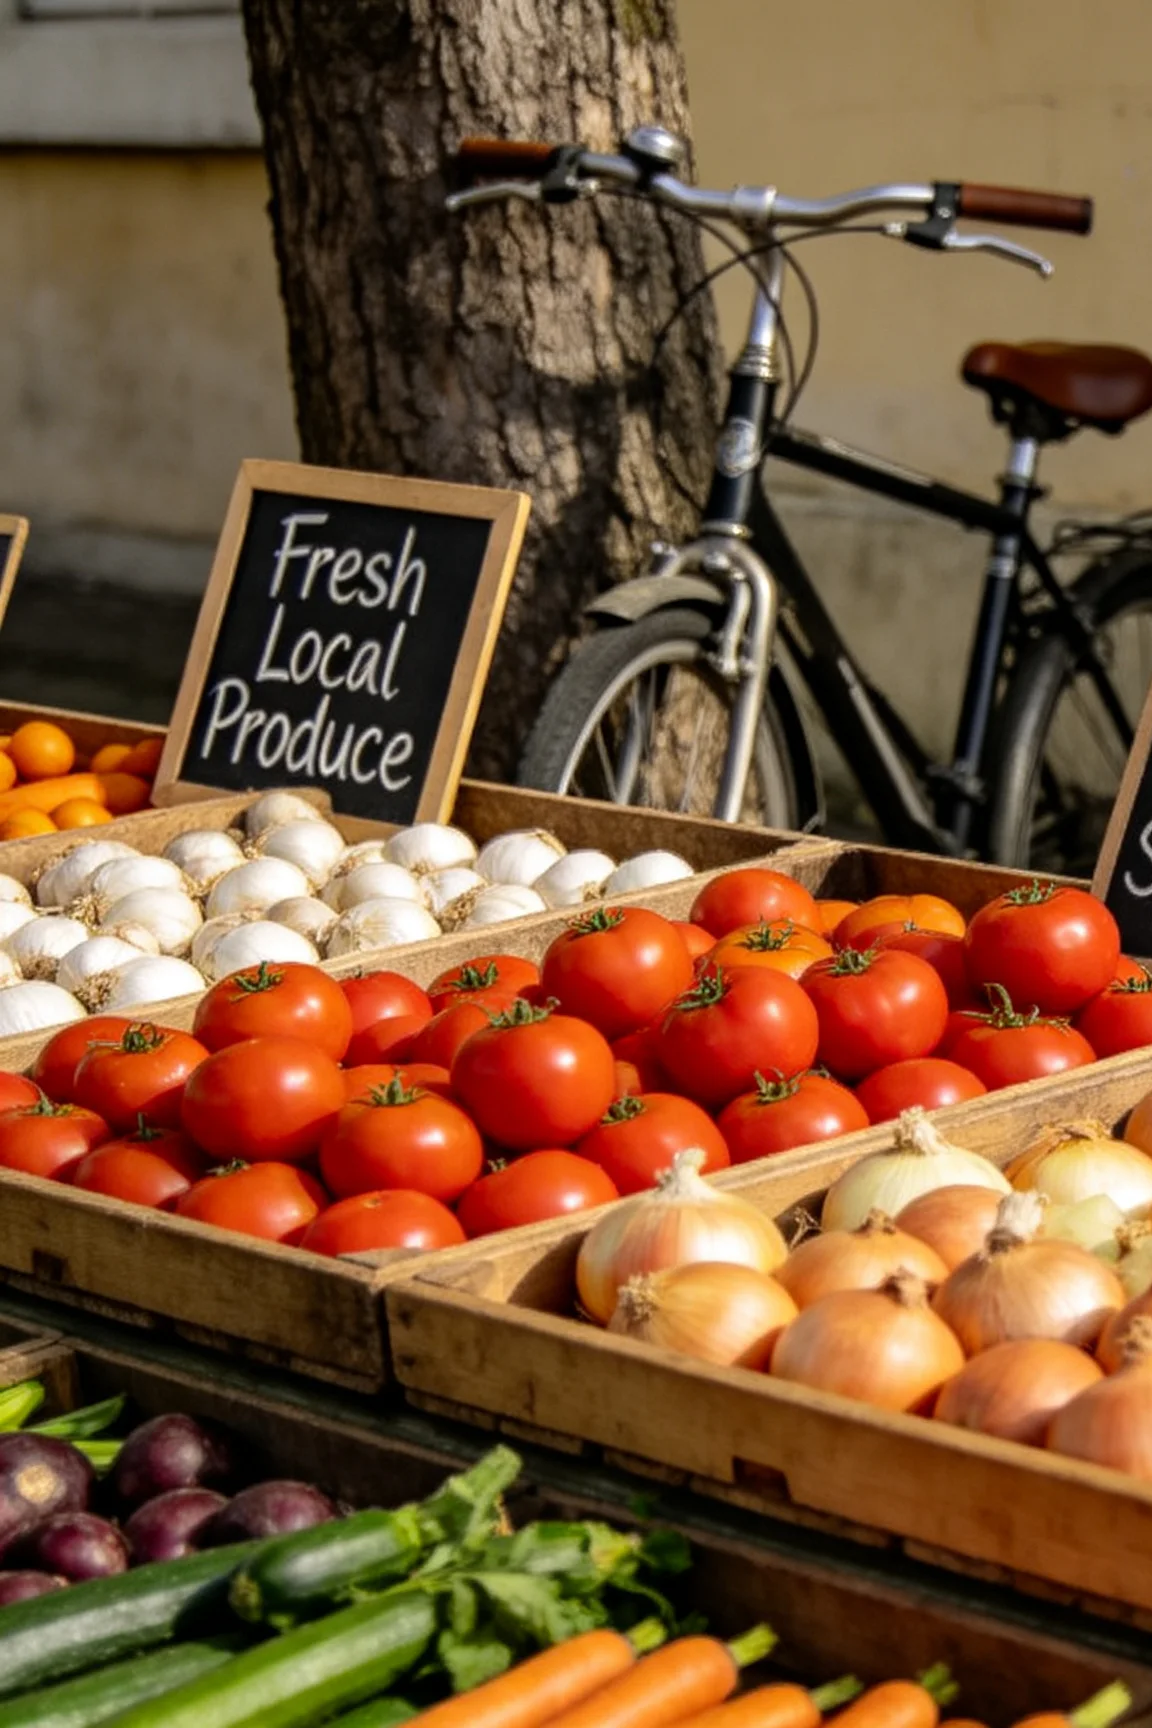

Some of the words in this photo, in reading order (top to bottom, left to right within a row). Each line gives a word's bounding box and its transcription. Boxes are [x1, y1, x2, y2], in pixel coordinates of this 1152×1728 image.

[269, 512, 427, 617] Fresh
[255, 603, 407, 701] Local
[201, 678, 414, 792] Produce
